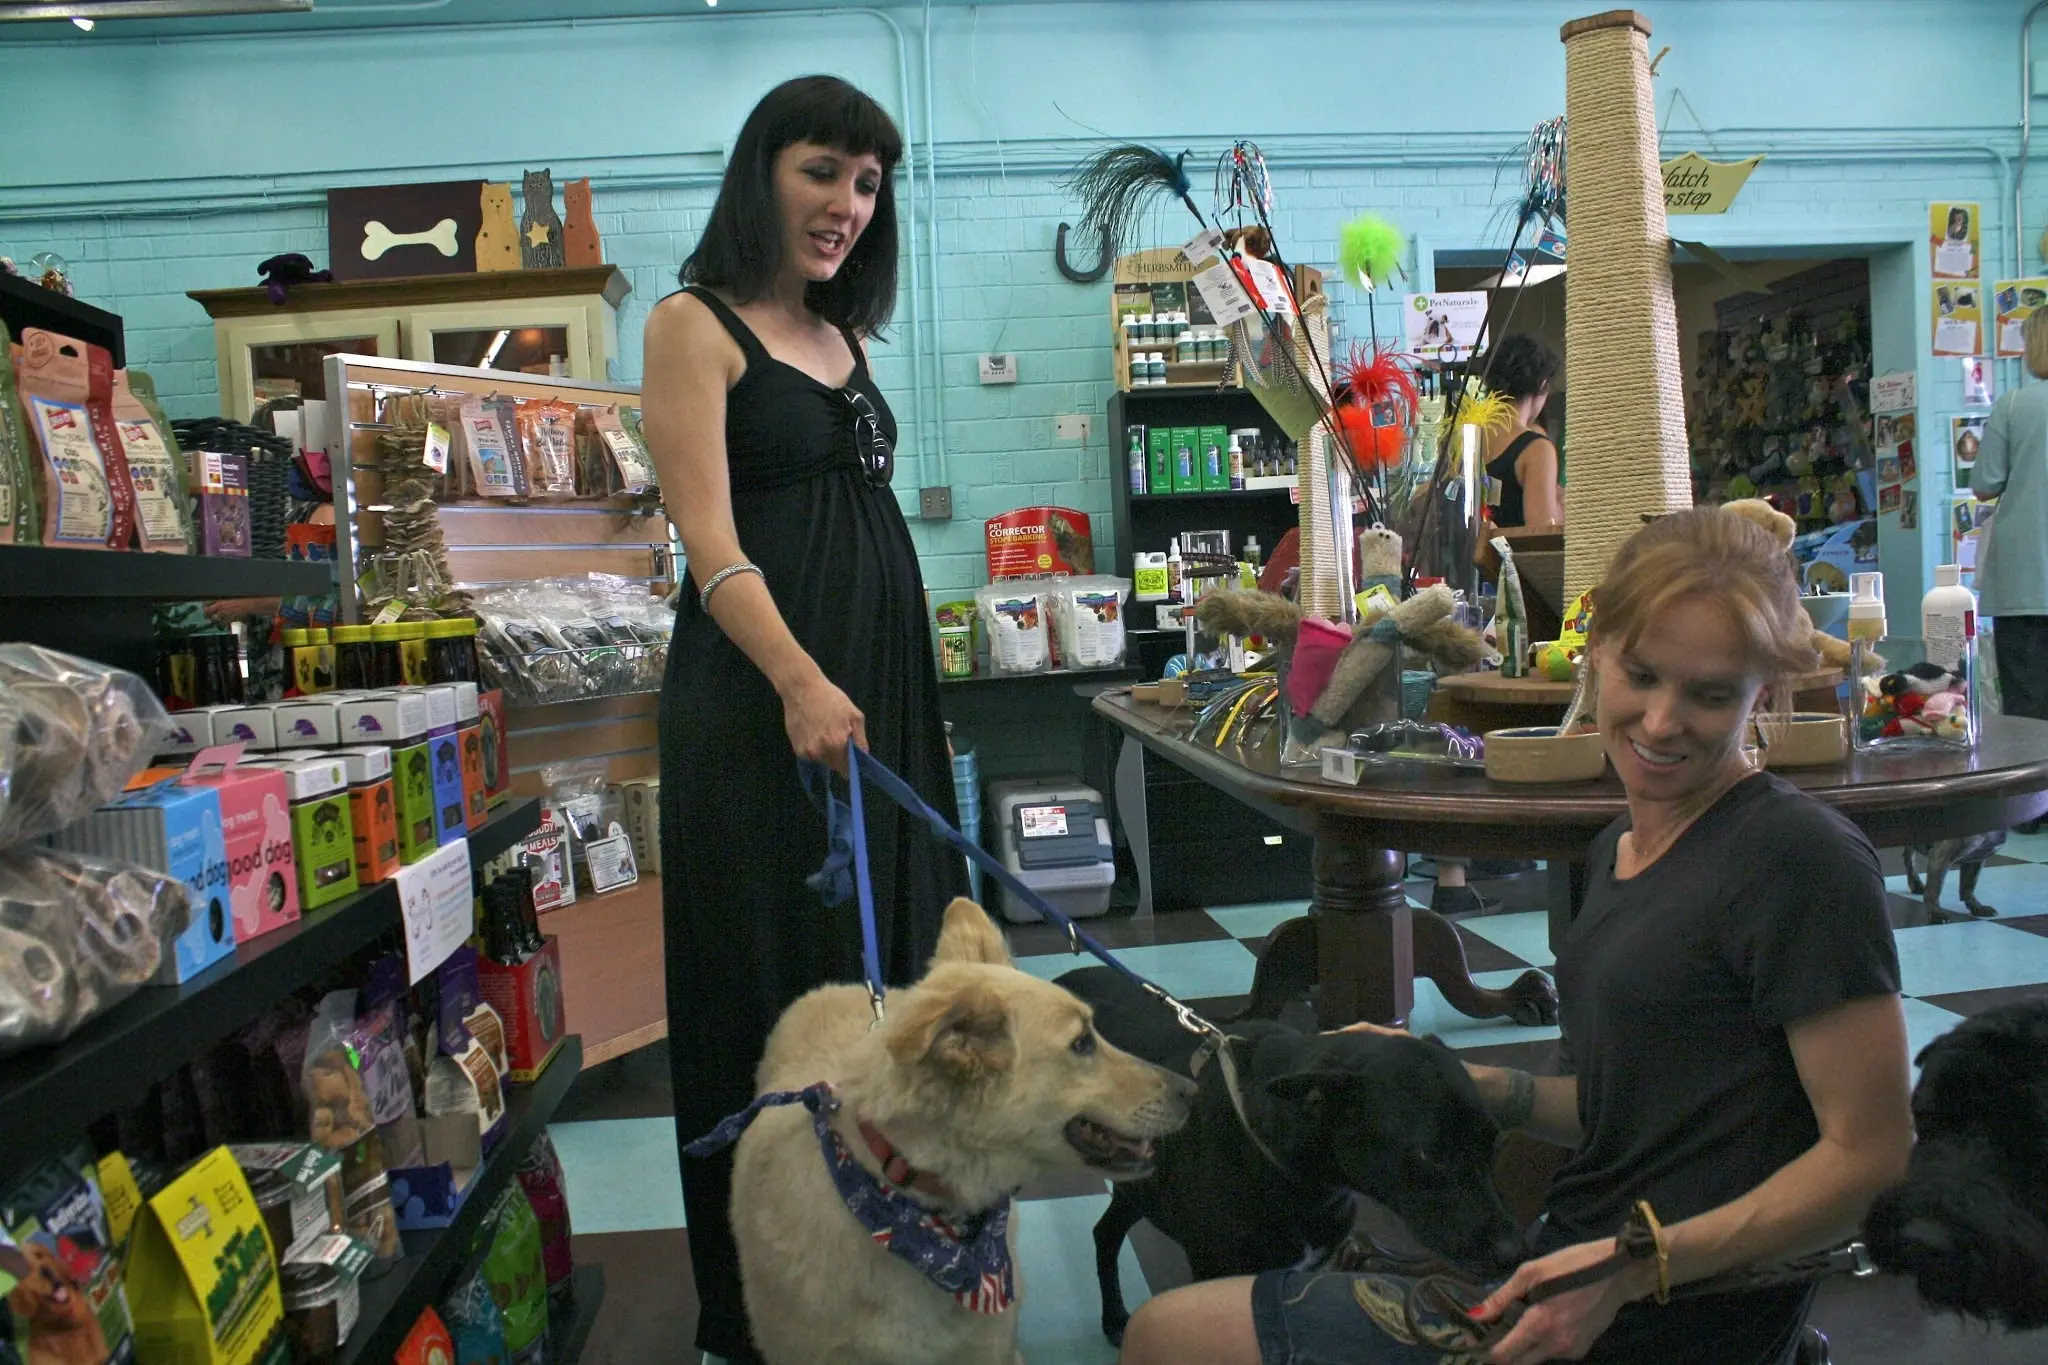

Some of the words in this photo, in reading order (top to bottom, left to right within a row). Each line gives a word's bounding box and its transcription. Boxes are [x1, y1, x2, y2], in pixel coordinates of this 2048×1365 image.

[1673, 189, 1712, 212] step
[989, 526, 1045, 537] CORRECTOR
[1013, 534, 1046, 542] BARKING
[265, 839, 291, 864] dog
[529, 836, 557, 852] MEALS
